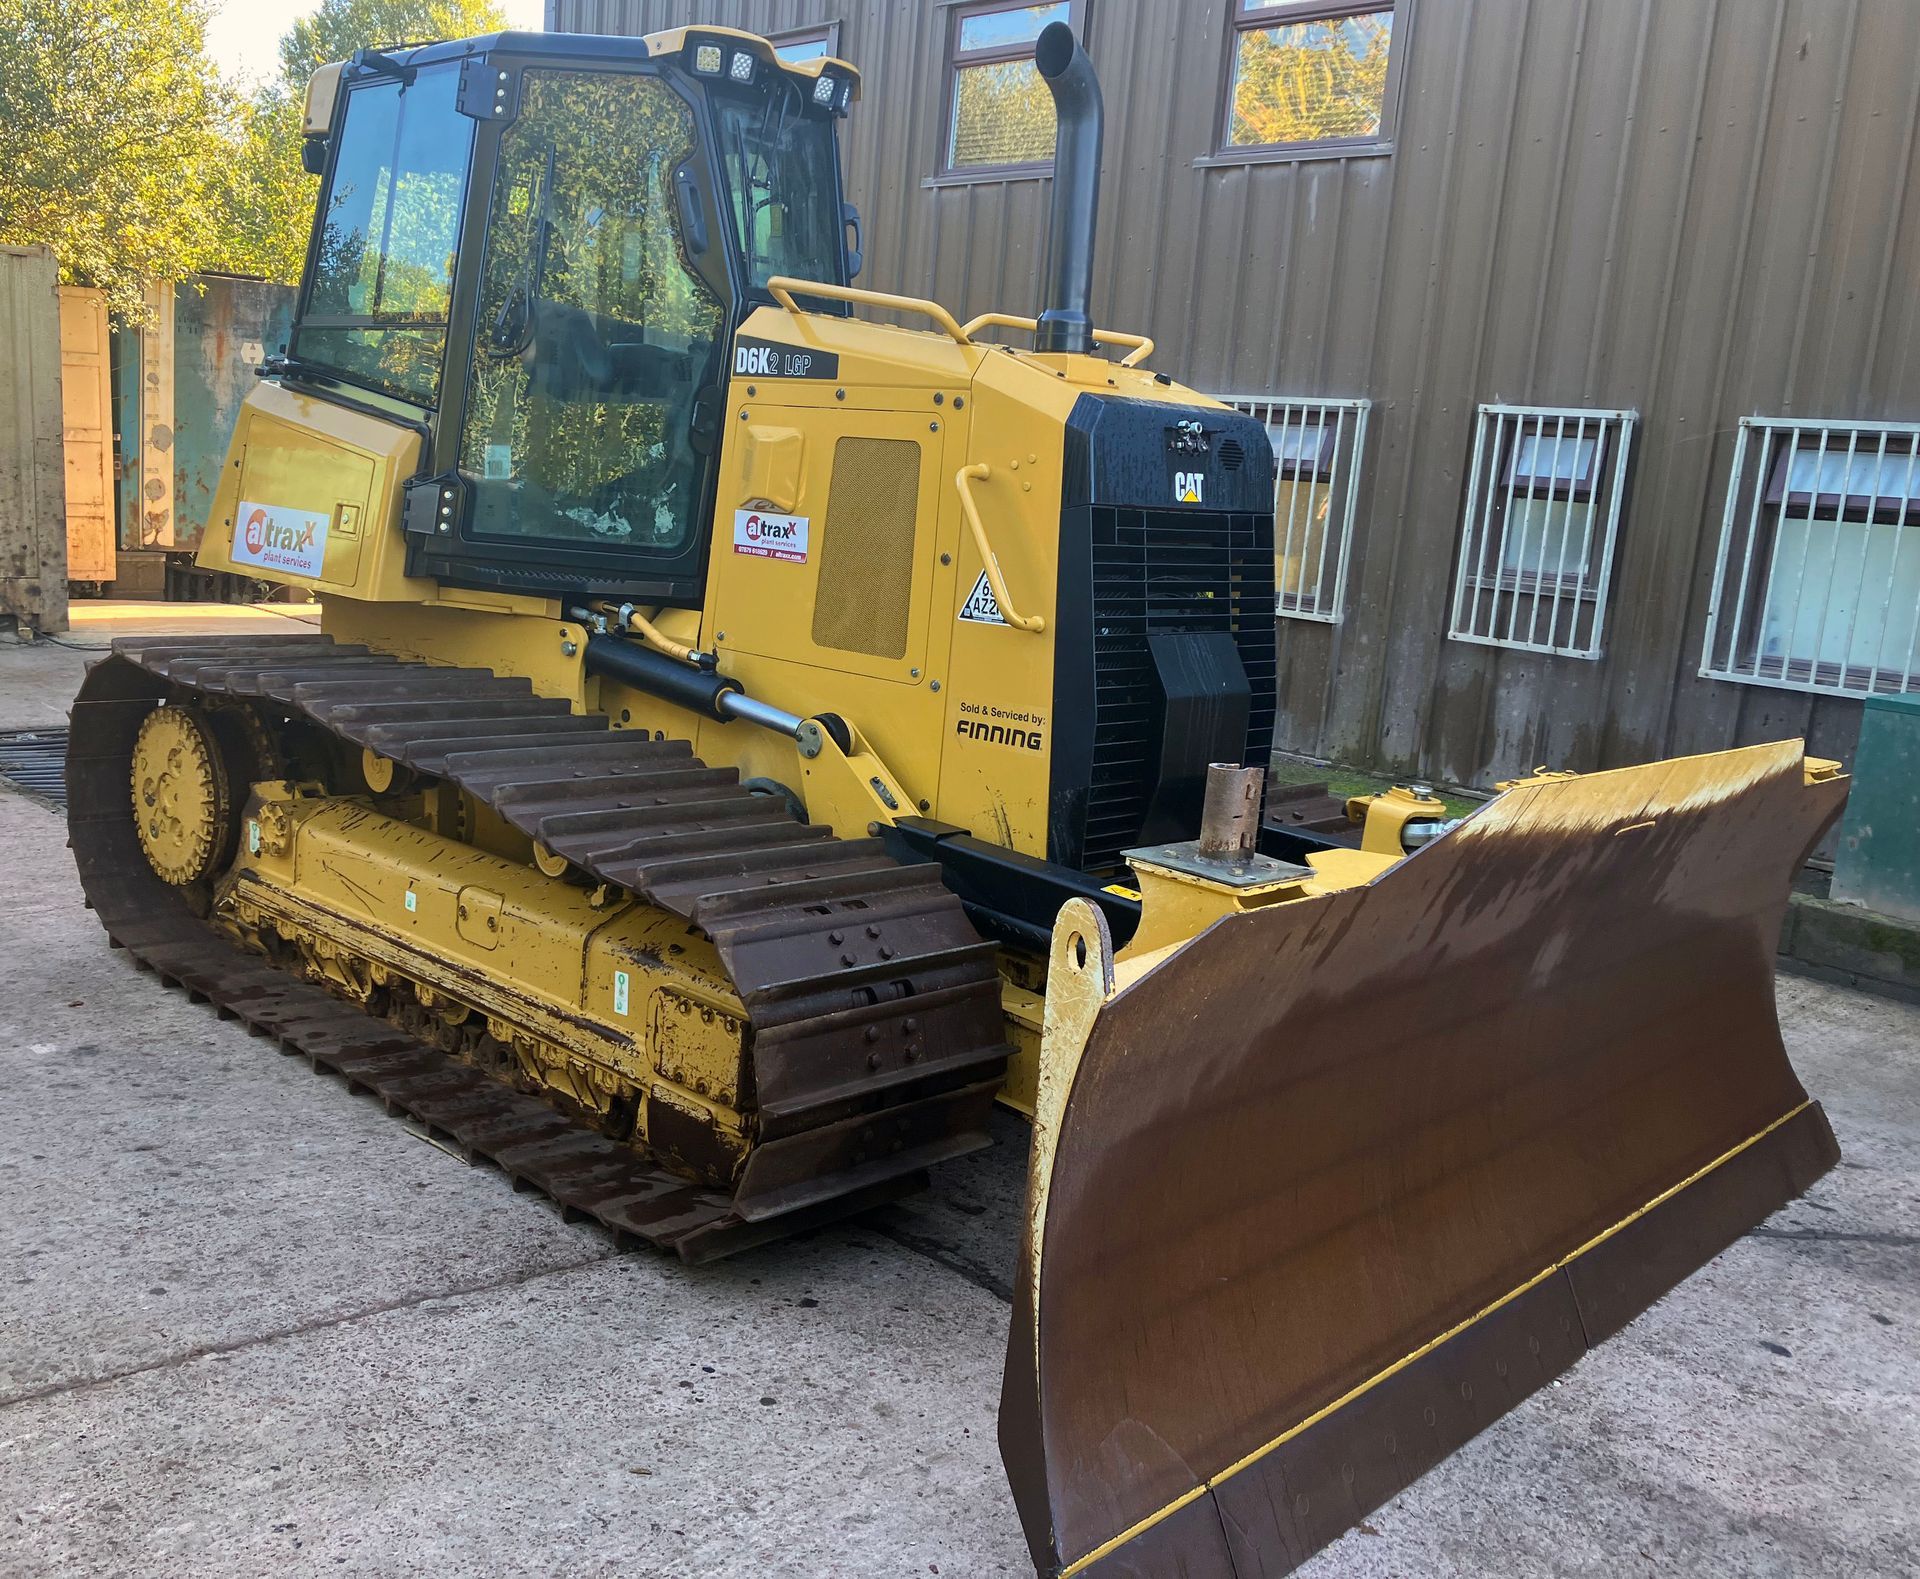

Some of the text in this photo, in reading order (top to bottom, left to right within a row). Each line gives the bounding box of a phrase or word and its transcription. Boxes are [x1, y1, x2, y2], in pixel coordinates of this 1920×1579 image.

[784, 354, 811, 375] LGP
[1175, 471, 1204, 502] CAT
[775, 540, 796, 548] services
[263, 550, 311, 569] plant services
[973, 597, 999, 615] AZ2
[960, 702, 1046, 726] Sold & Serviced by:
